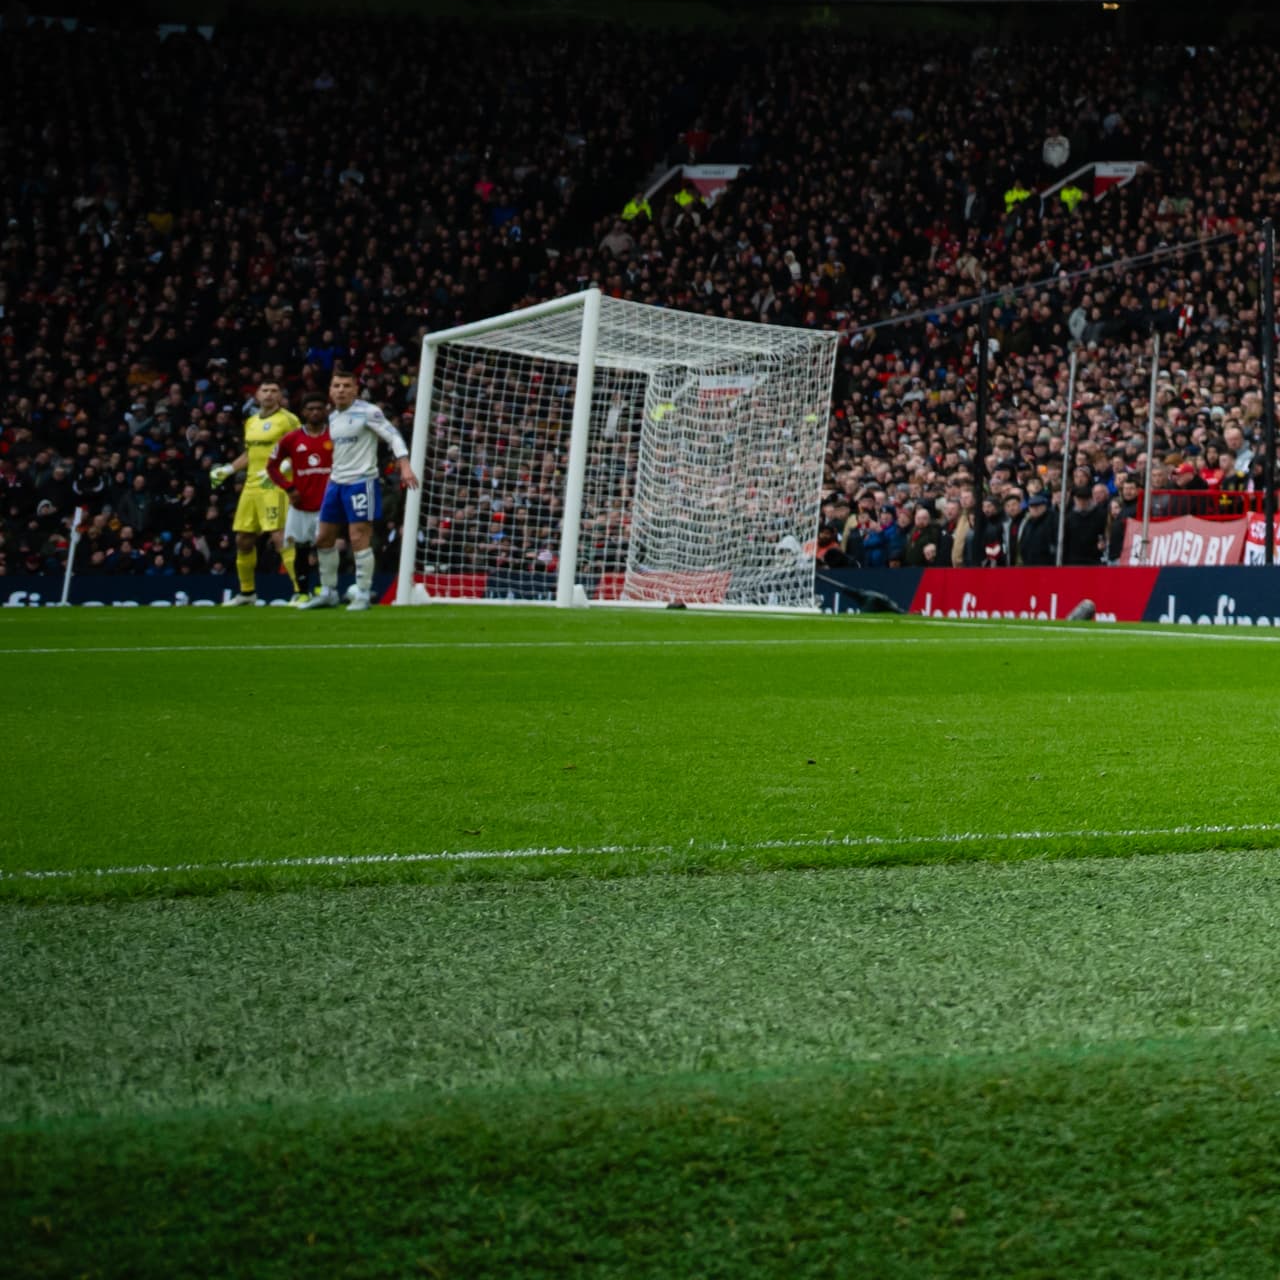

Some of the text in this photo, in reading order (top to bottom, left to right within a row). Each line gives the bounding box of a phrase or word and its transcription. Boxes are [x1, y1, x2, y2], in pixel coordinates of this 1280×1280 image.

[350, 493, 368, 511] 12
[1128, 530, 1204, 566] BINDED
[1204, 535, 1235, 566] BY
